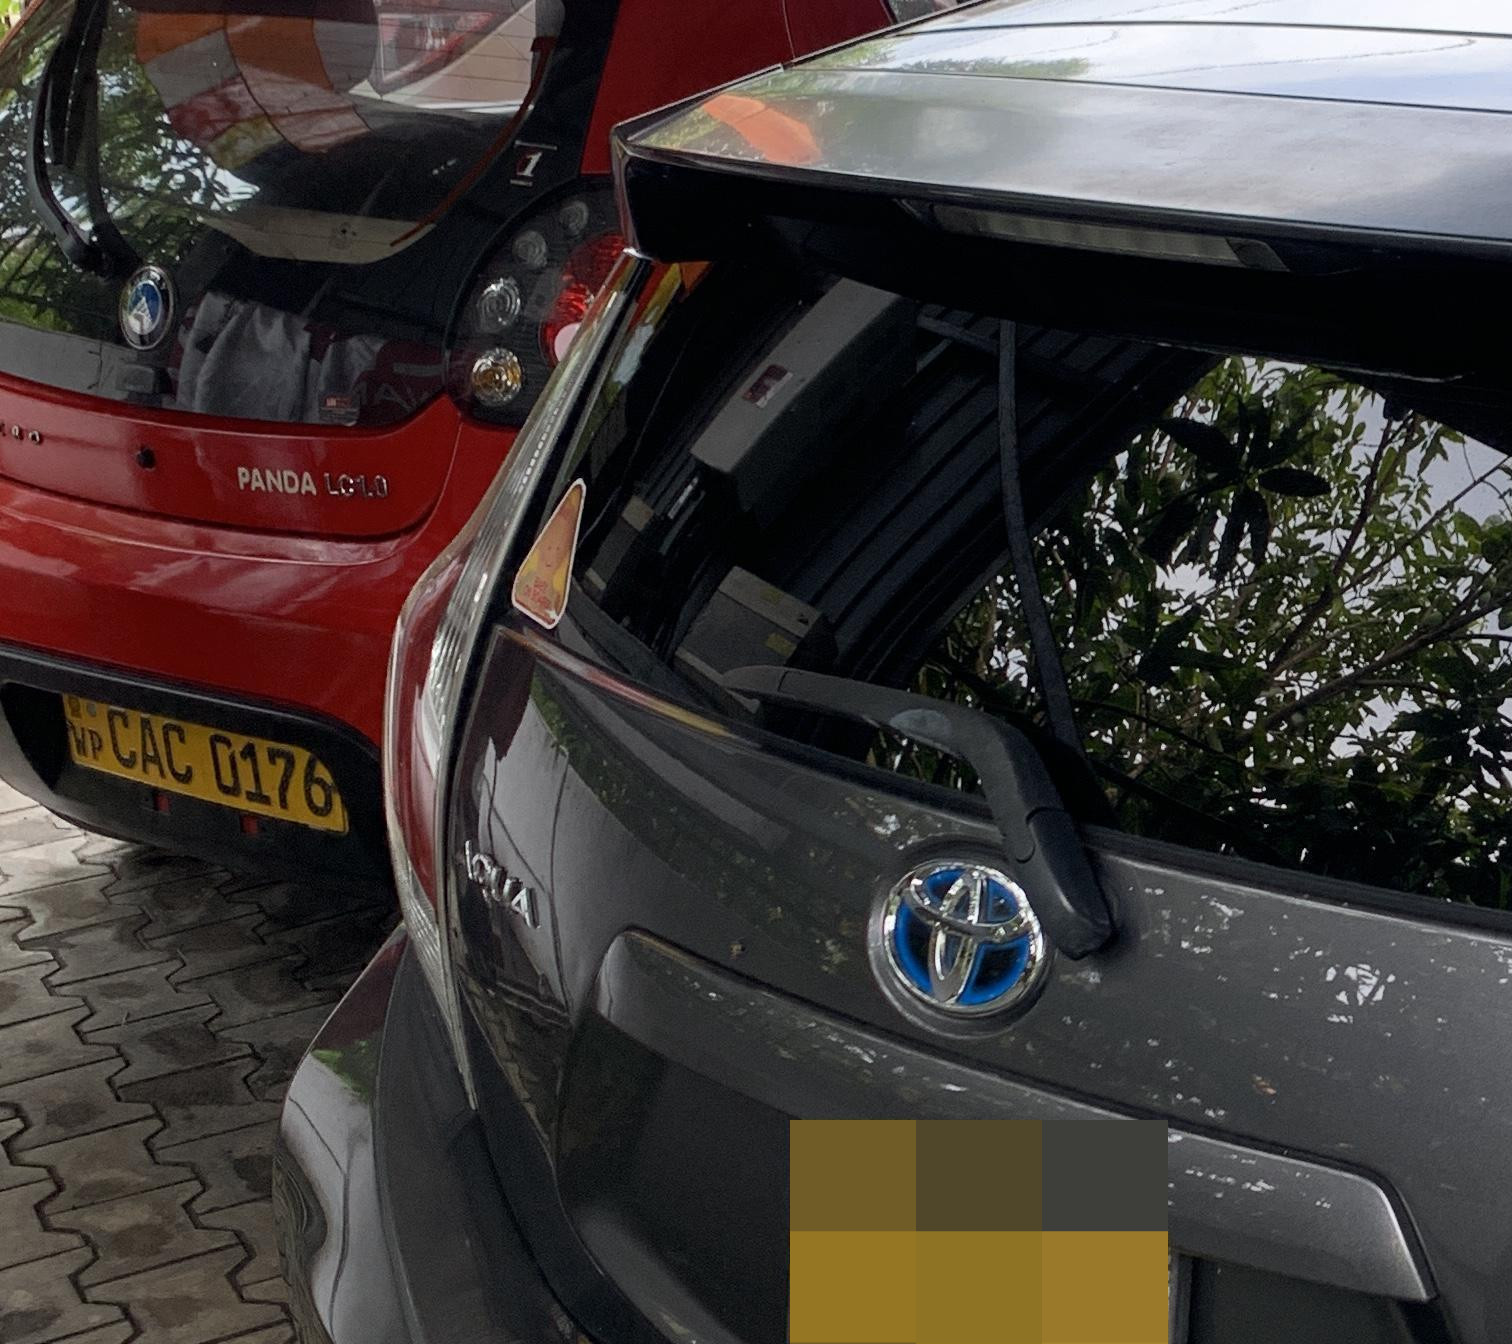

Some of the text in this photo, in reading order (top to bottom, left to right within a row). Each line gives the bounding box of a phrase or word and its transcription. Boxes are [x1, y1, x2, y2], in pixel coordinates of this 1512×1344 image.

[237, 466, 317, 496] PANDA
[107, 706, 194, 785] CAC
[208, 732, 334, 818] 0176
